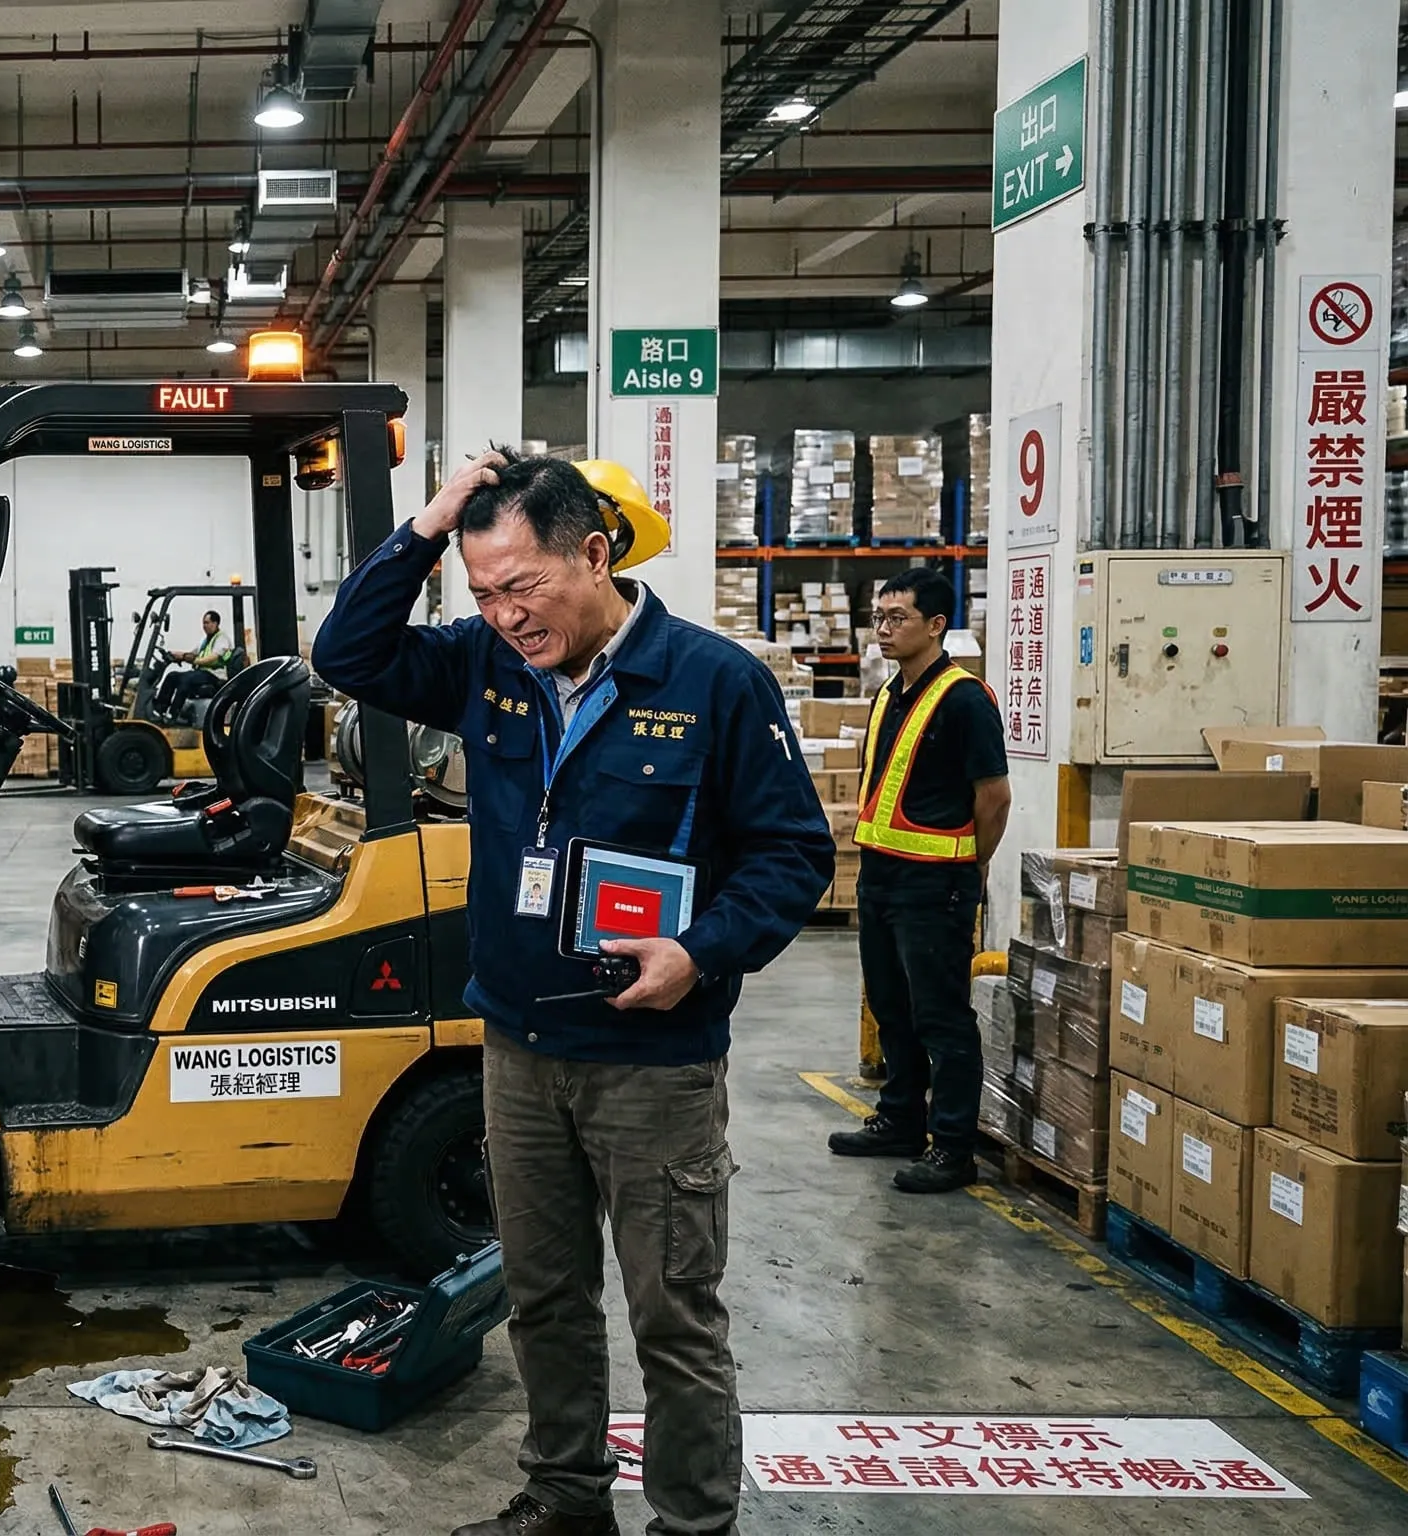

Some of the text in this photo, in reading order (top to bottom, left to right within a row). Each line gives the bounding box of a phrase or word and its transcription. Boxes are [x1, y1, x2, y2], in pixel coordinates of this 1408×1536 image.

[1020, 94, 1057, 151] 出口
[1003, 151, 1049, 210] EXIT
[640, 337, 689, 363] 路口
[623, 368, 703, 388] Aisle 9
[159, 387, 229, 409] FAULT
[92, 440, 170, 449] WANG LOGISTICS
[1019, 429, 1045, 517] 9
[1304, 370, 1366, 613] 嚴禁煙火
[212, 996, 336, 1013] MITSUBISHI
[174, 1045, 336, 1070] WANG LOGISTICS
[837, 1420, 1123, 1451] 中文標示
[754, 1454, 1286, 1492] 通道請保持暢通
